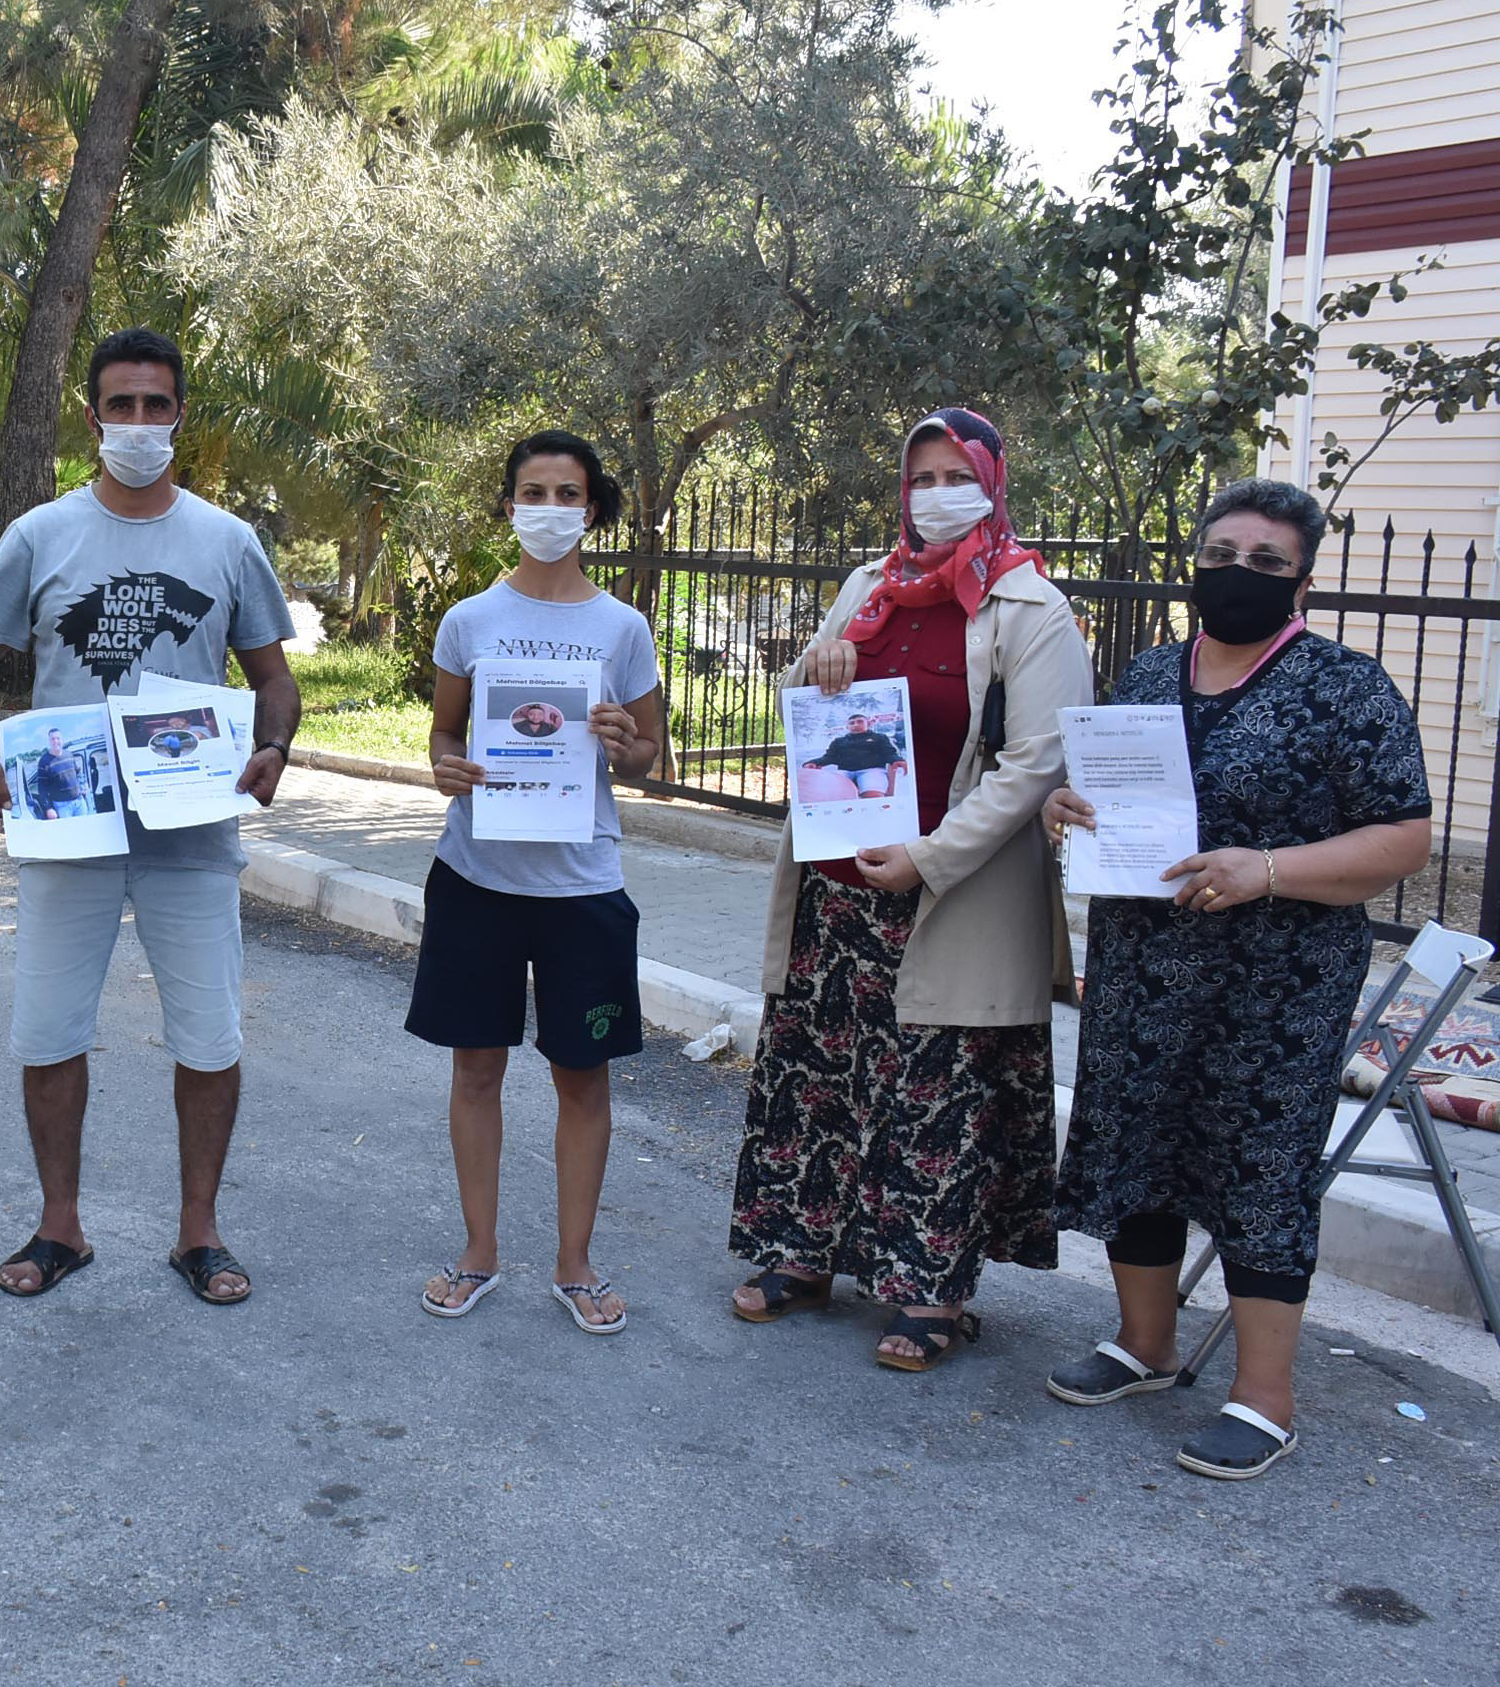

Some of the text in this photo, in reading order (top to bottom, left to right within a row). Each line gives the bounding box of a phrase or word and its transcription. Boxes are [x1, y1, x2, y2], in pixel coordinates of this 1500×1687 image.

[137, 576, 158, 585] THE
[103, 584, 165, 602] LONE
[102, 600, 166, 618] WOLF
[97, 617, 140, 632] DIES
[141, 626, 156, 634] THE
[87, 632, 144, 650] PACK
[84, 650, 135, 660] SURVIVES
